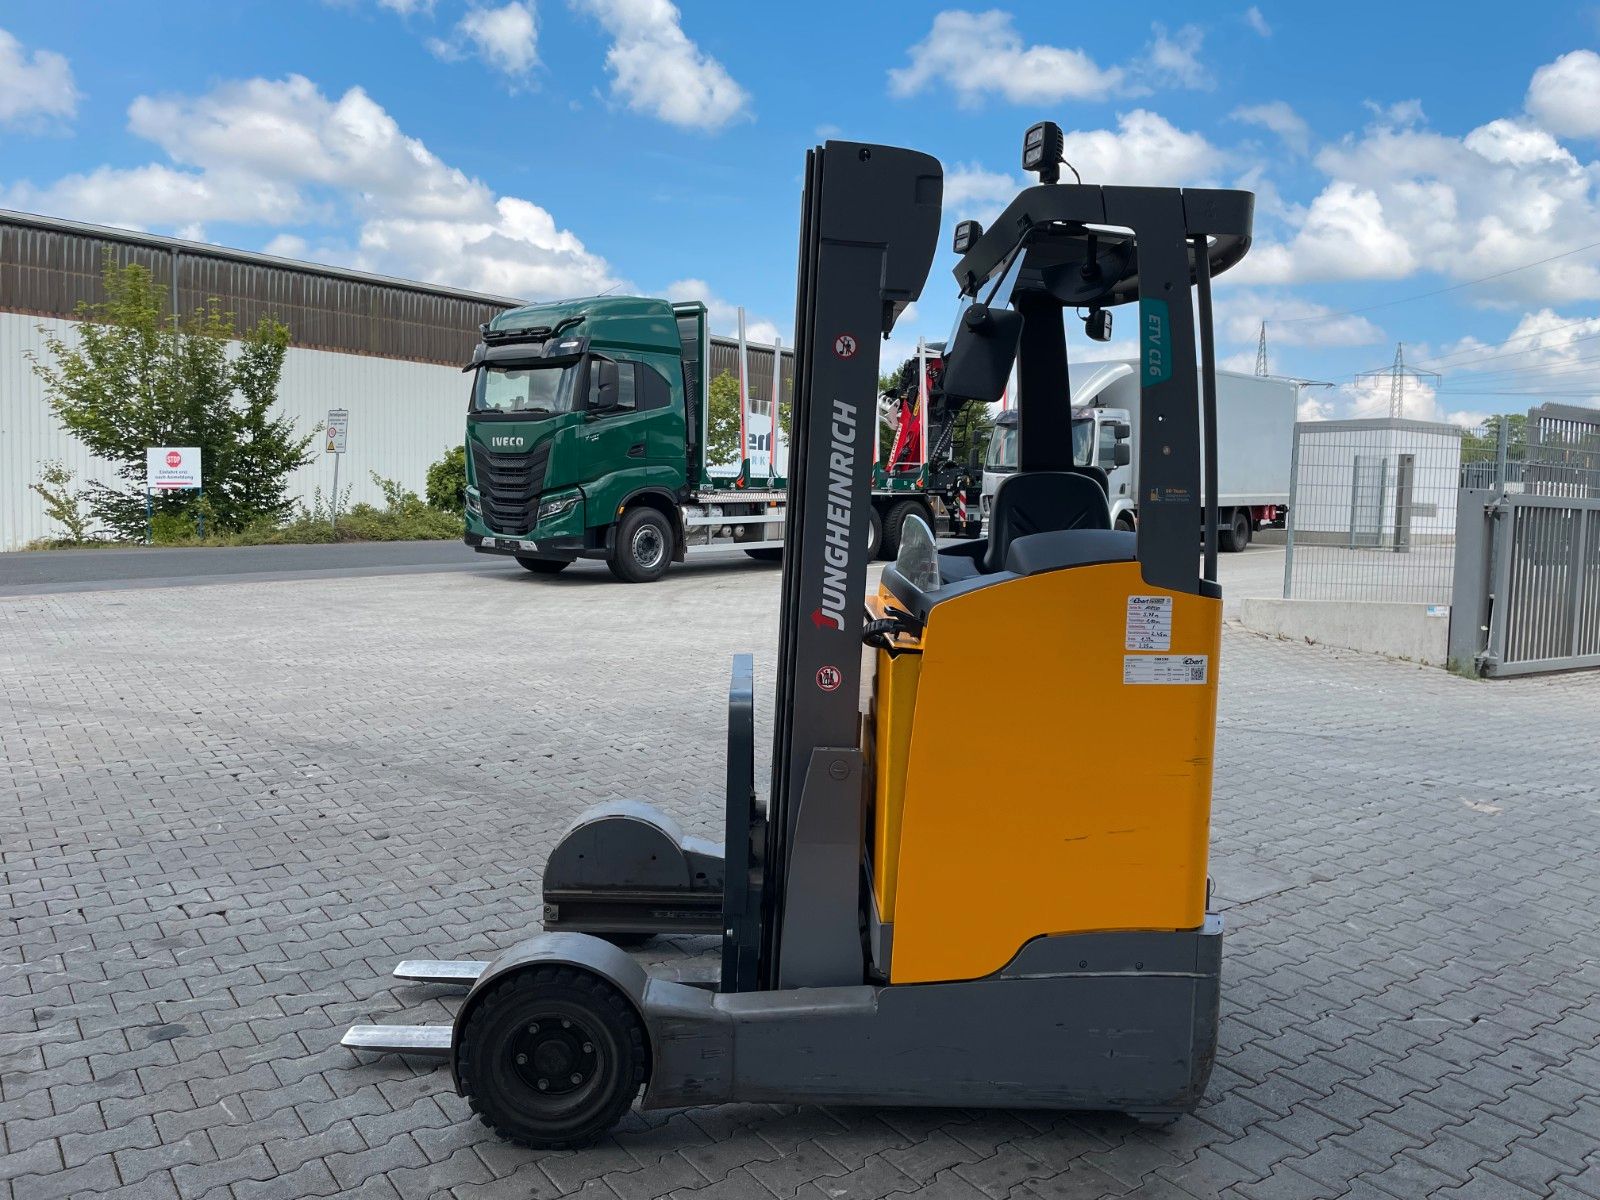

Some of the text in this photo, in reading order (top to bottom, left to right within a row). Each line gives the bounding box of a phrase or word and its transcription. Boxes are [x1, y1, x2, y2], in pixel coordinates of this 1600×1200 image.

[1148, 314, 1162, 377] ETV C16
[167, 455, 181, 464] STOP
[491, 436, 524, 447] IVECO
[821, 399, 857, 631] JUNGHEINRICH
